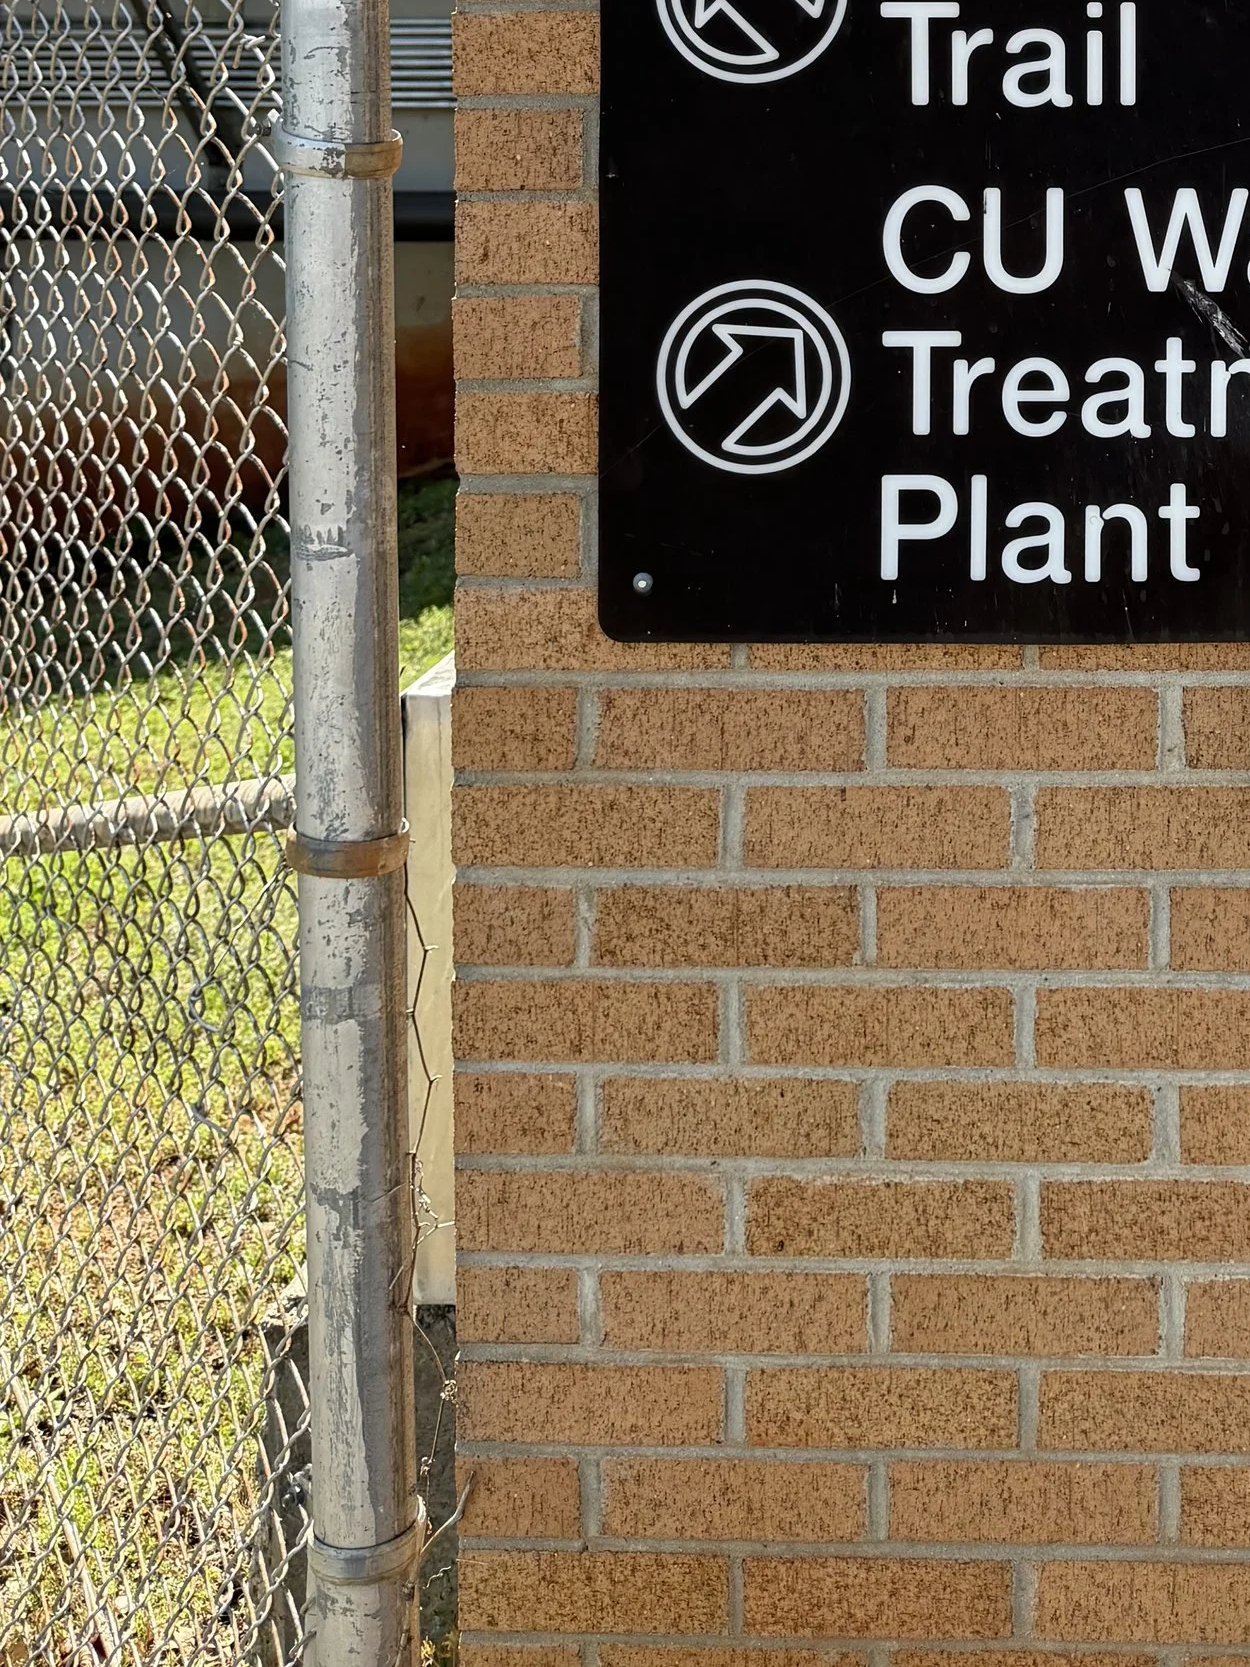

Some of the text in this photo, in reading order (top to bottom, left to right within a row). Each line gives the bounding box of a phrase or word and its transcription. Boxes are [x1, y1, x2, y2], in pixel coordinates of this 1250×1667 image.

[880, 1, 1137, 107] Trail
[882, 185, 1064, 294] CU
[880, 474, 1201, 584] Plant
